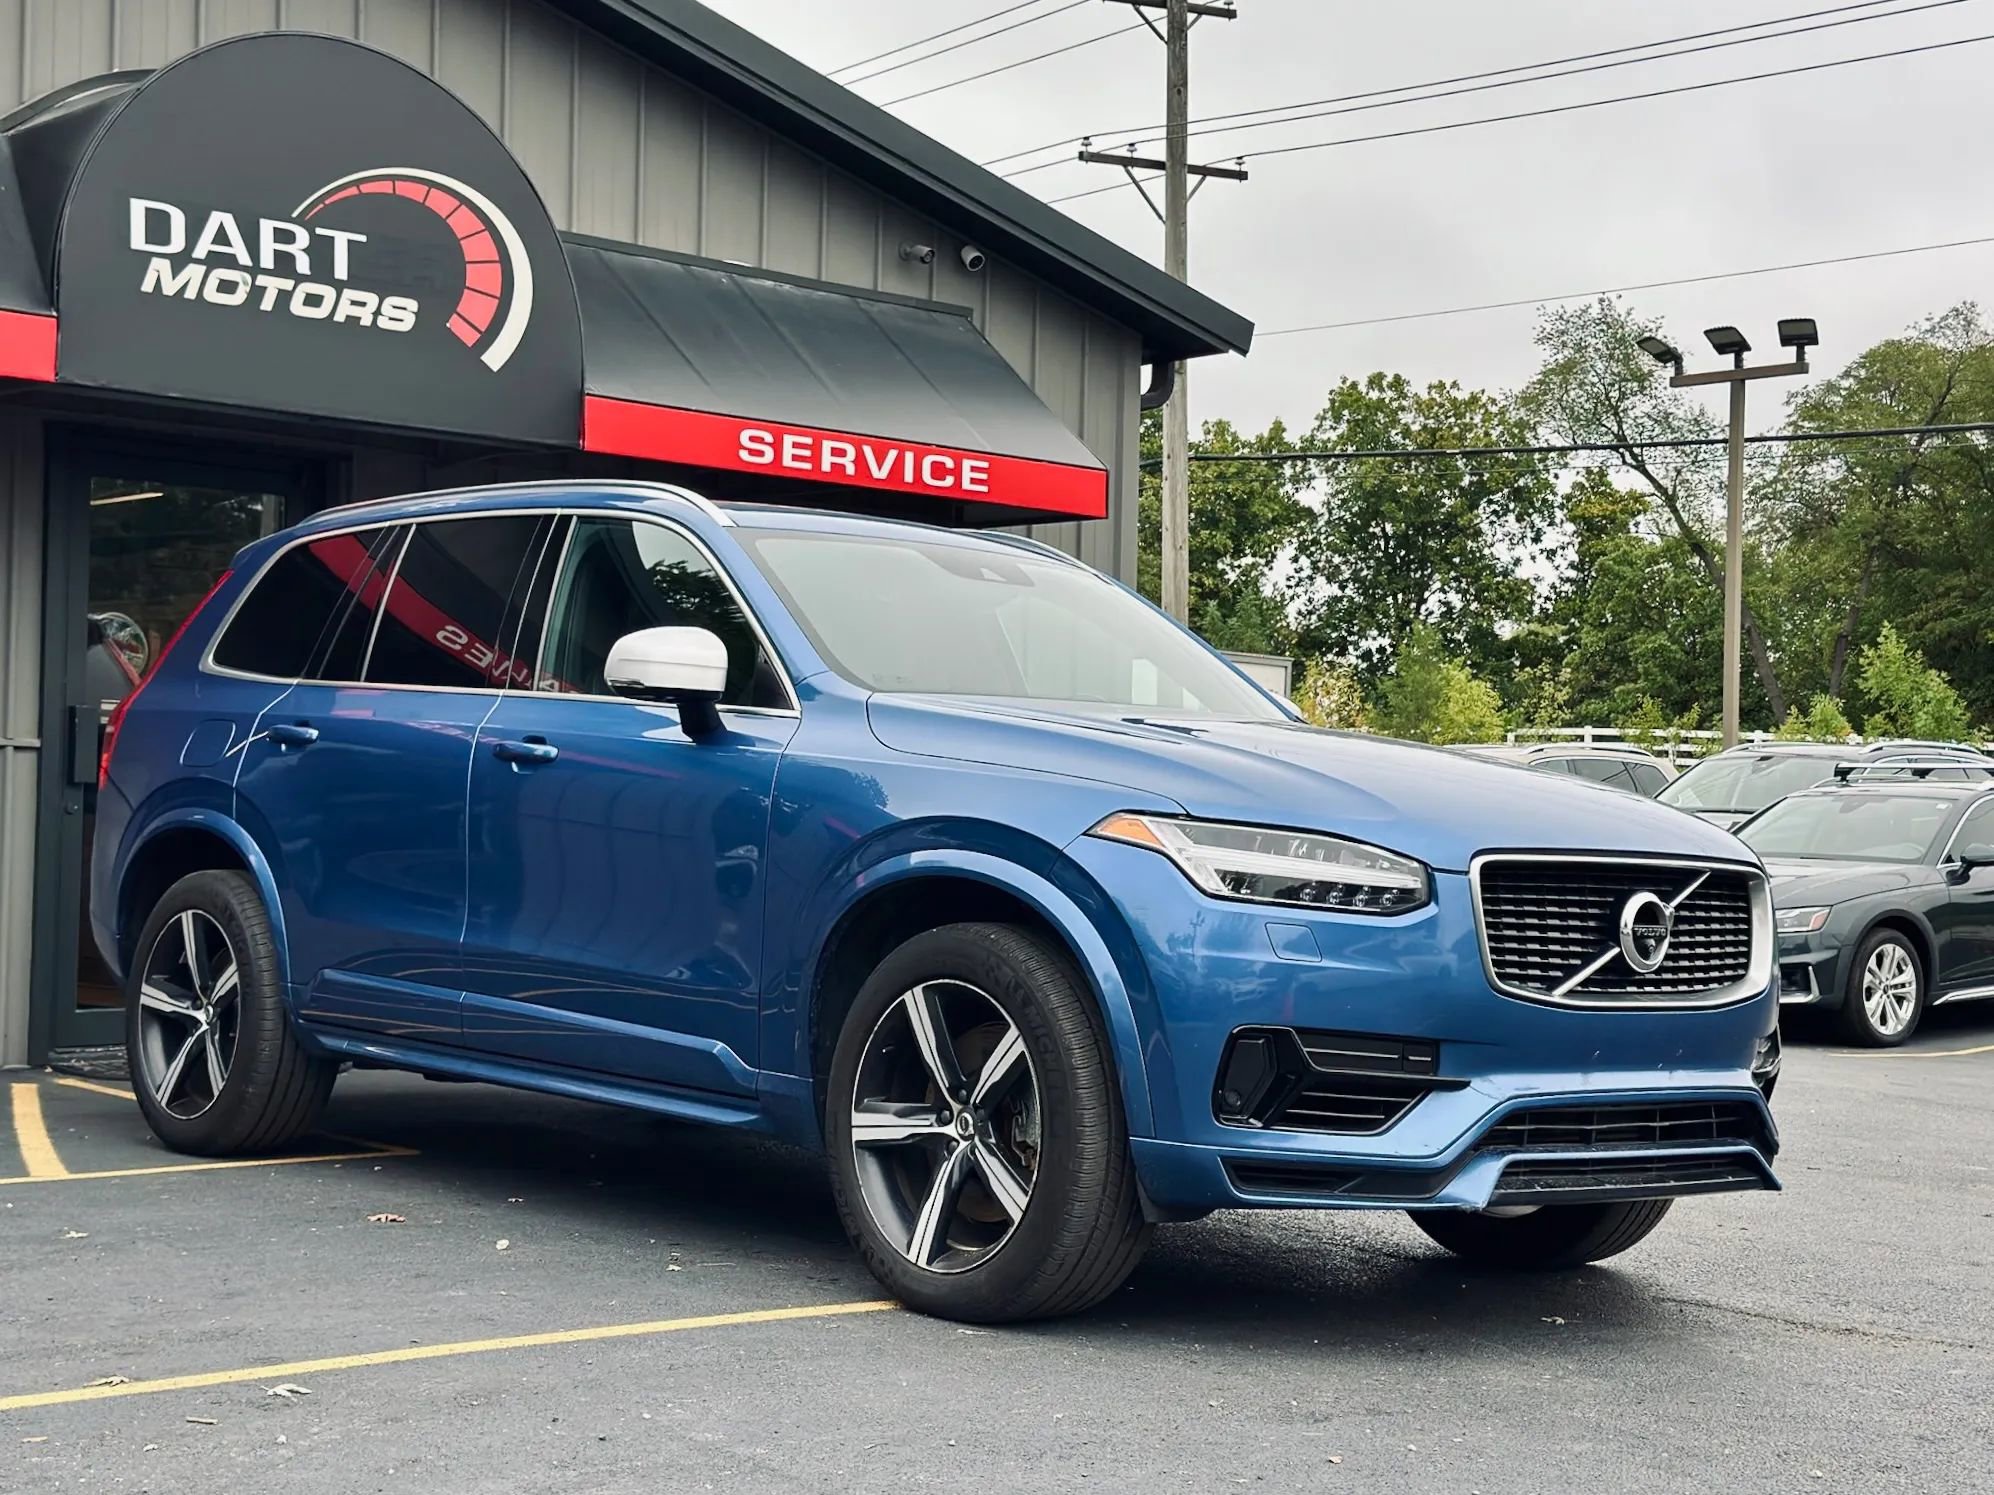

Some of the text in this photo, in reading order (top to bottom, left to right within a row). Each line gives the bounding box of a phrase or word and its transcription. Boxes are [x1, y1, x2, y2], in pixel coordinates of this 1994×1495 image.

[129, 197, 368, 281] DART
[140, 256, 419, 332] MOTORS
[738, 428, 990, 493] SERVICE
[1633, 927, 1667, 936] VOLVO
